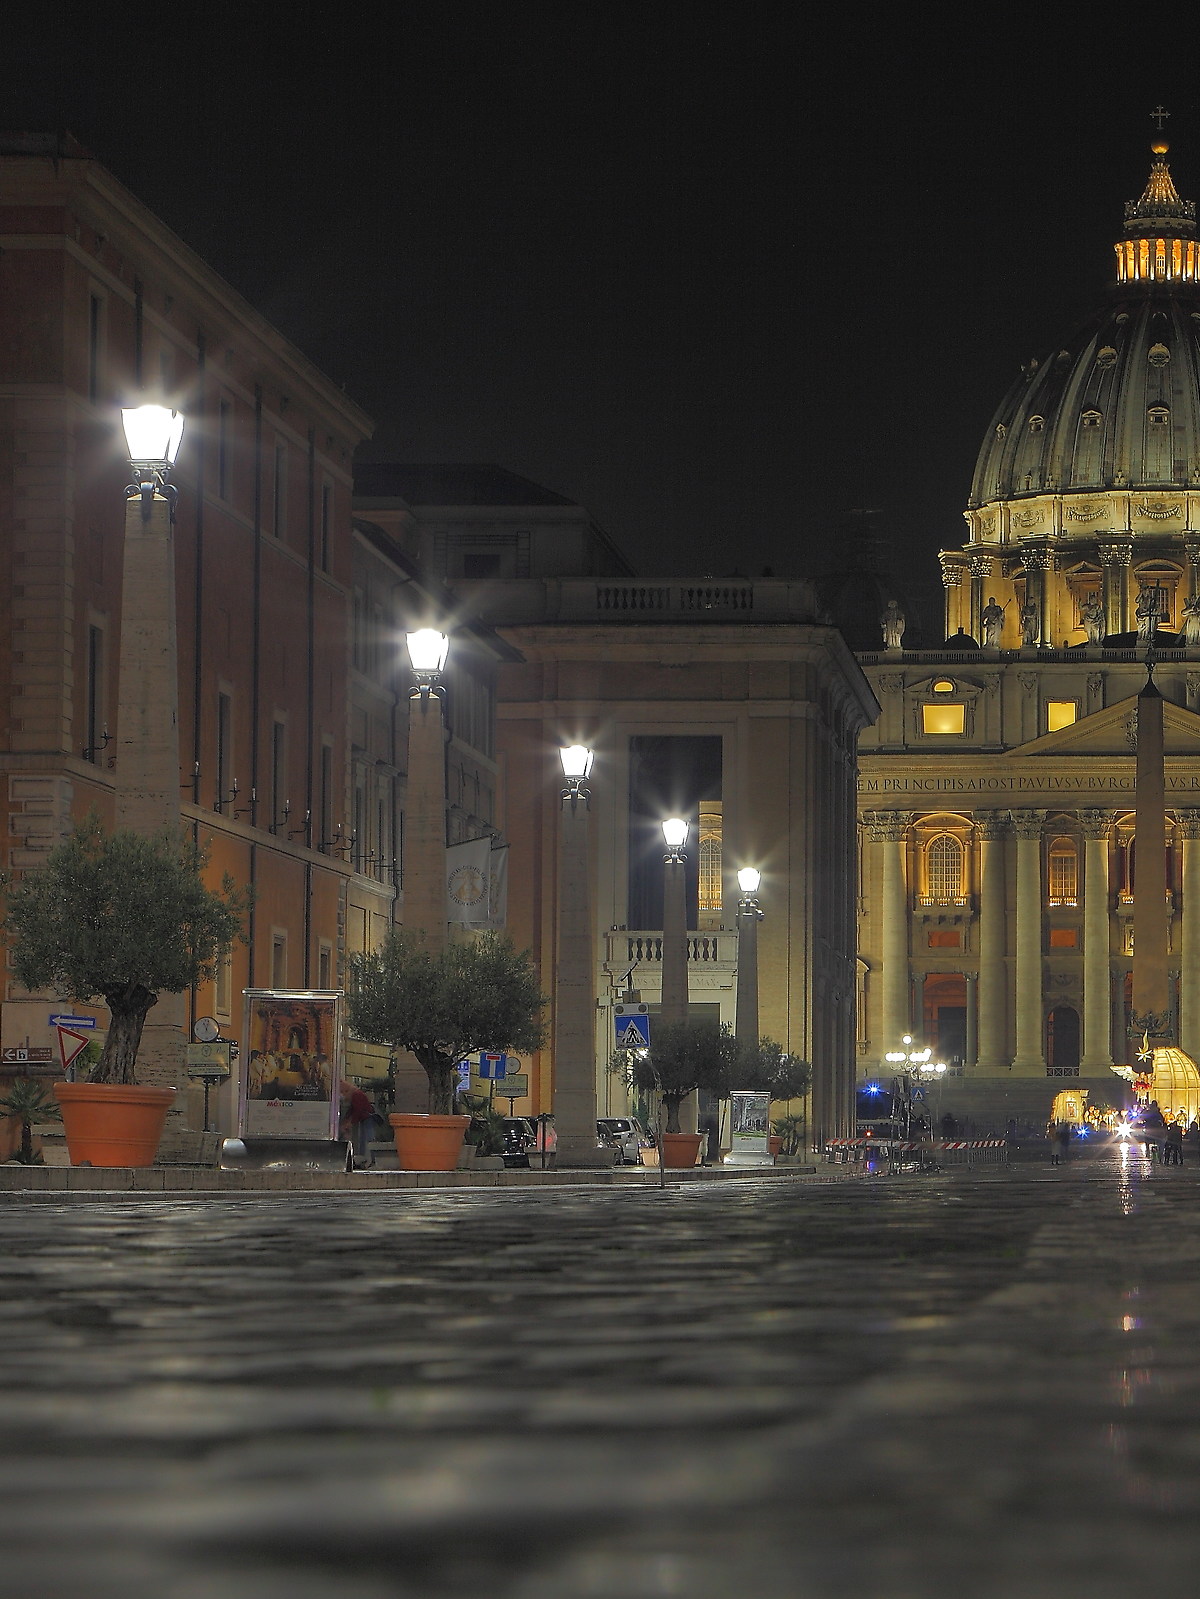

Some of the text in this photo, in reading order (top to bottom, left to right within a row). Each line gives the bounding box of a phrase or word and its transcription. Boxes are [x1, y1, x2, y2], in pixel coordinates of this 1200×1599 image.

[883, 778, 964, 791] PRINCIPIS
[967, 777, 1016, 790] APOST
[1019, 777, 1072, 789] PAVLVS
[1074, 777, 1084, 788] V
